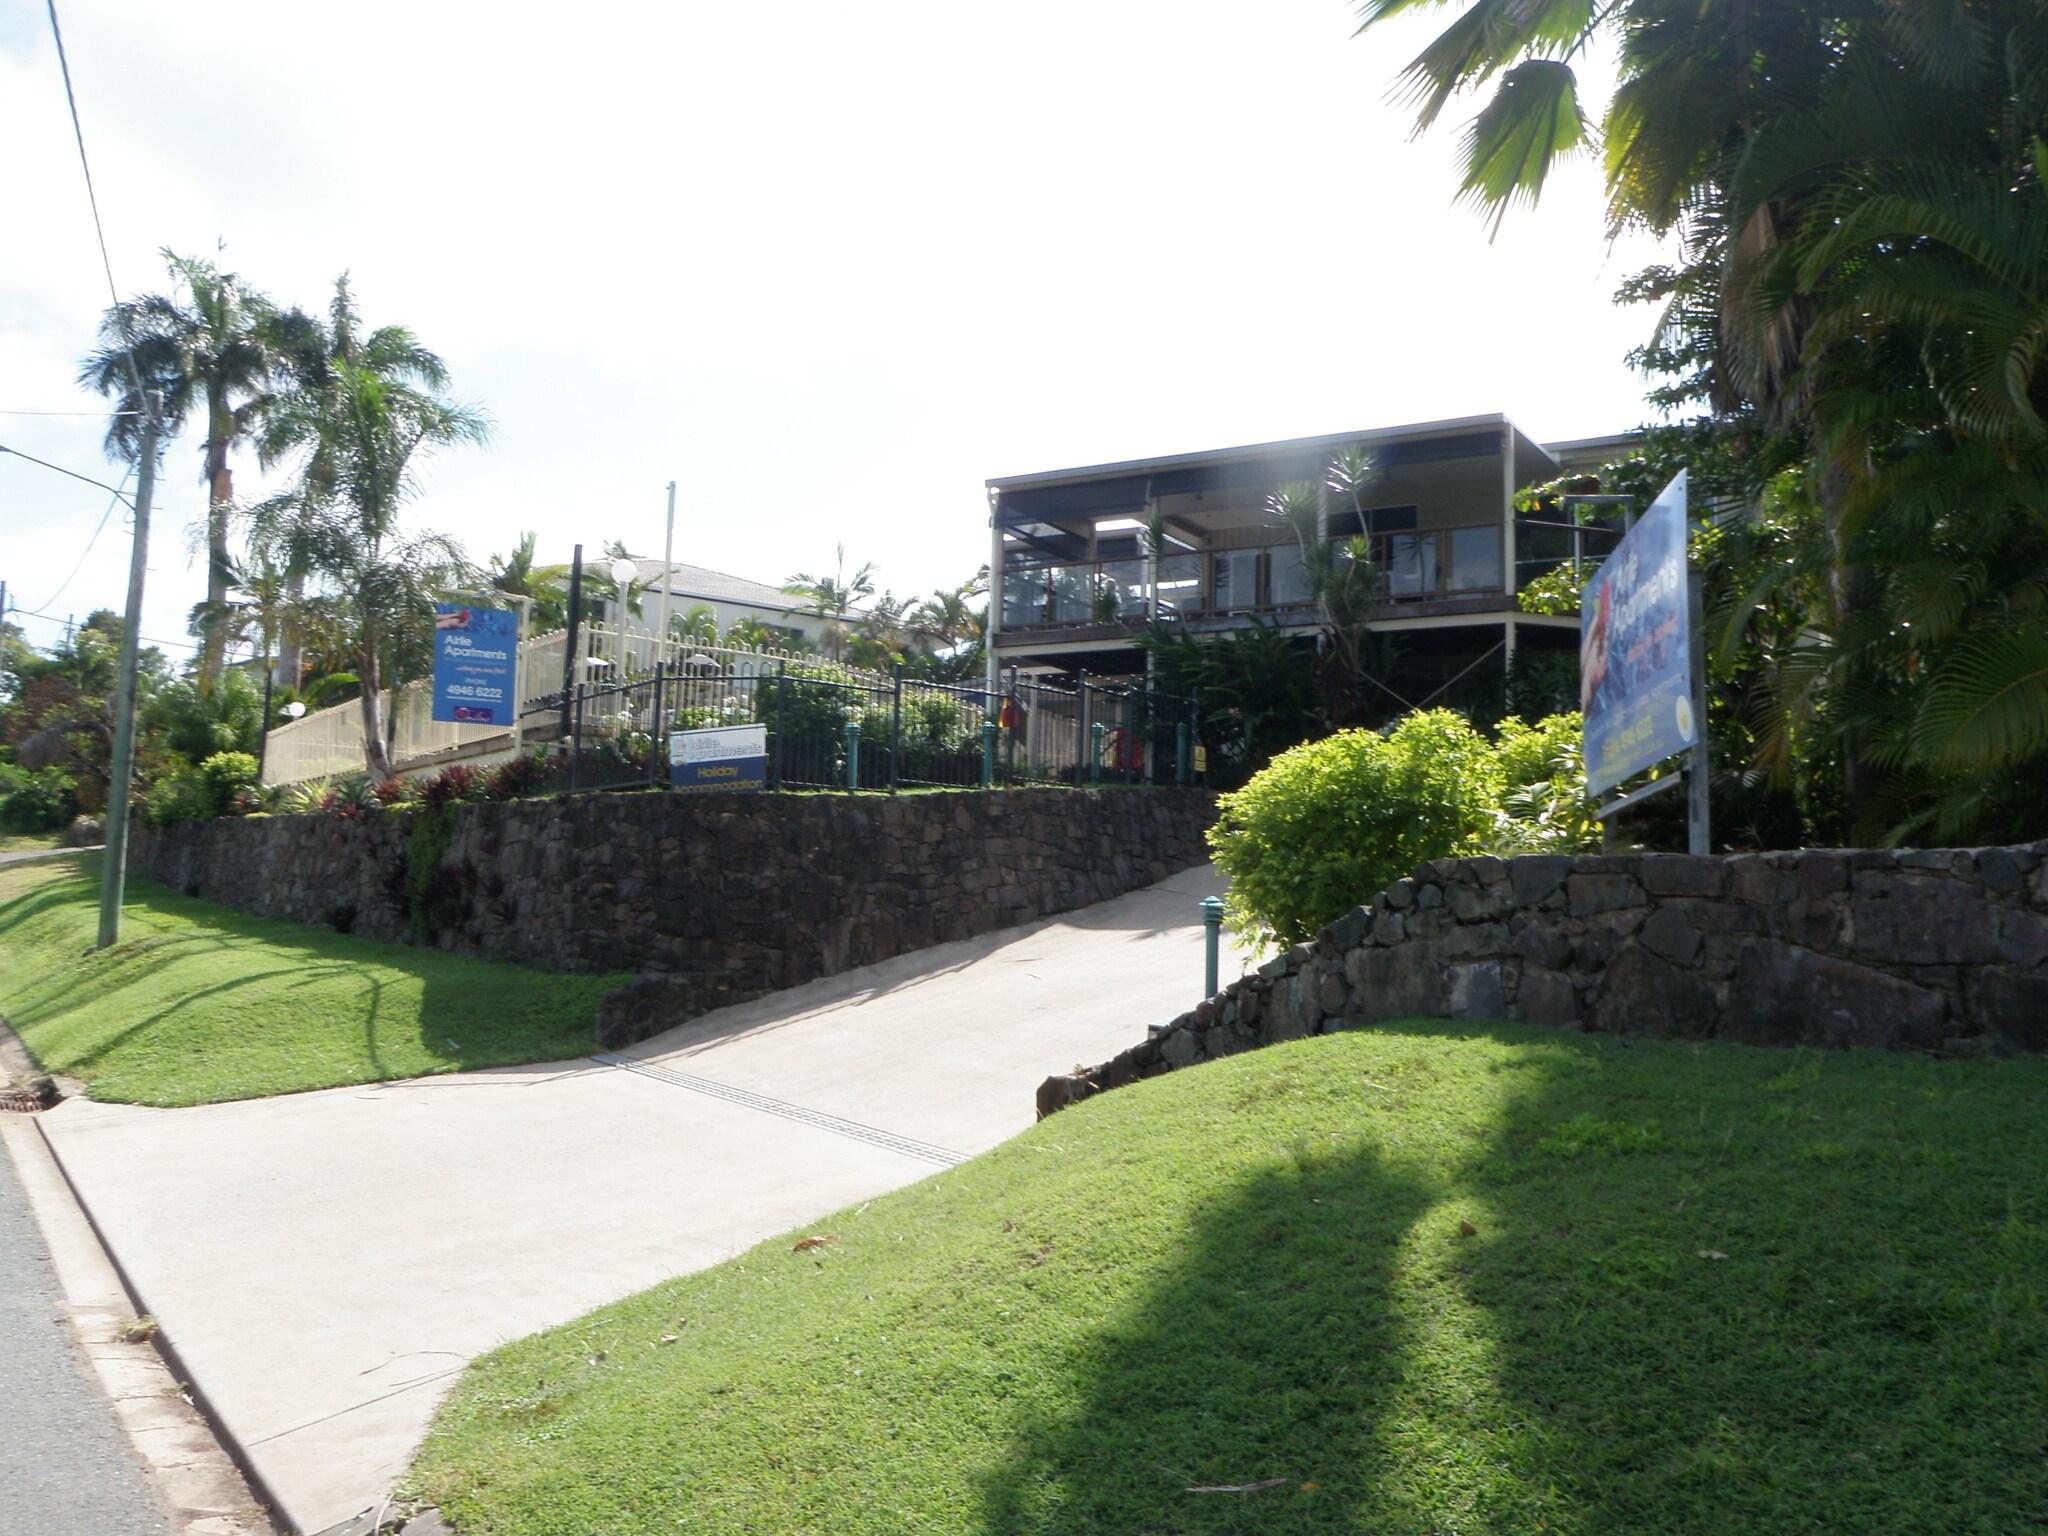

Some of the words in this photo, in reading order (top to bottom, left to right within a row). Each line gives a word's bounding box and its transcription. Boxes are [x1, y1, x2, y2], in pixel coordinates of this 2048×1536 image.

[444, 635, 473, 647] Airlie
[444, 646, 508, 660] Apartments
[446, 685, 474, 696] 4946
[475, 687, 503, 698] 6222
